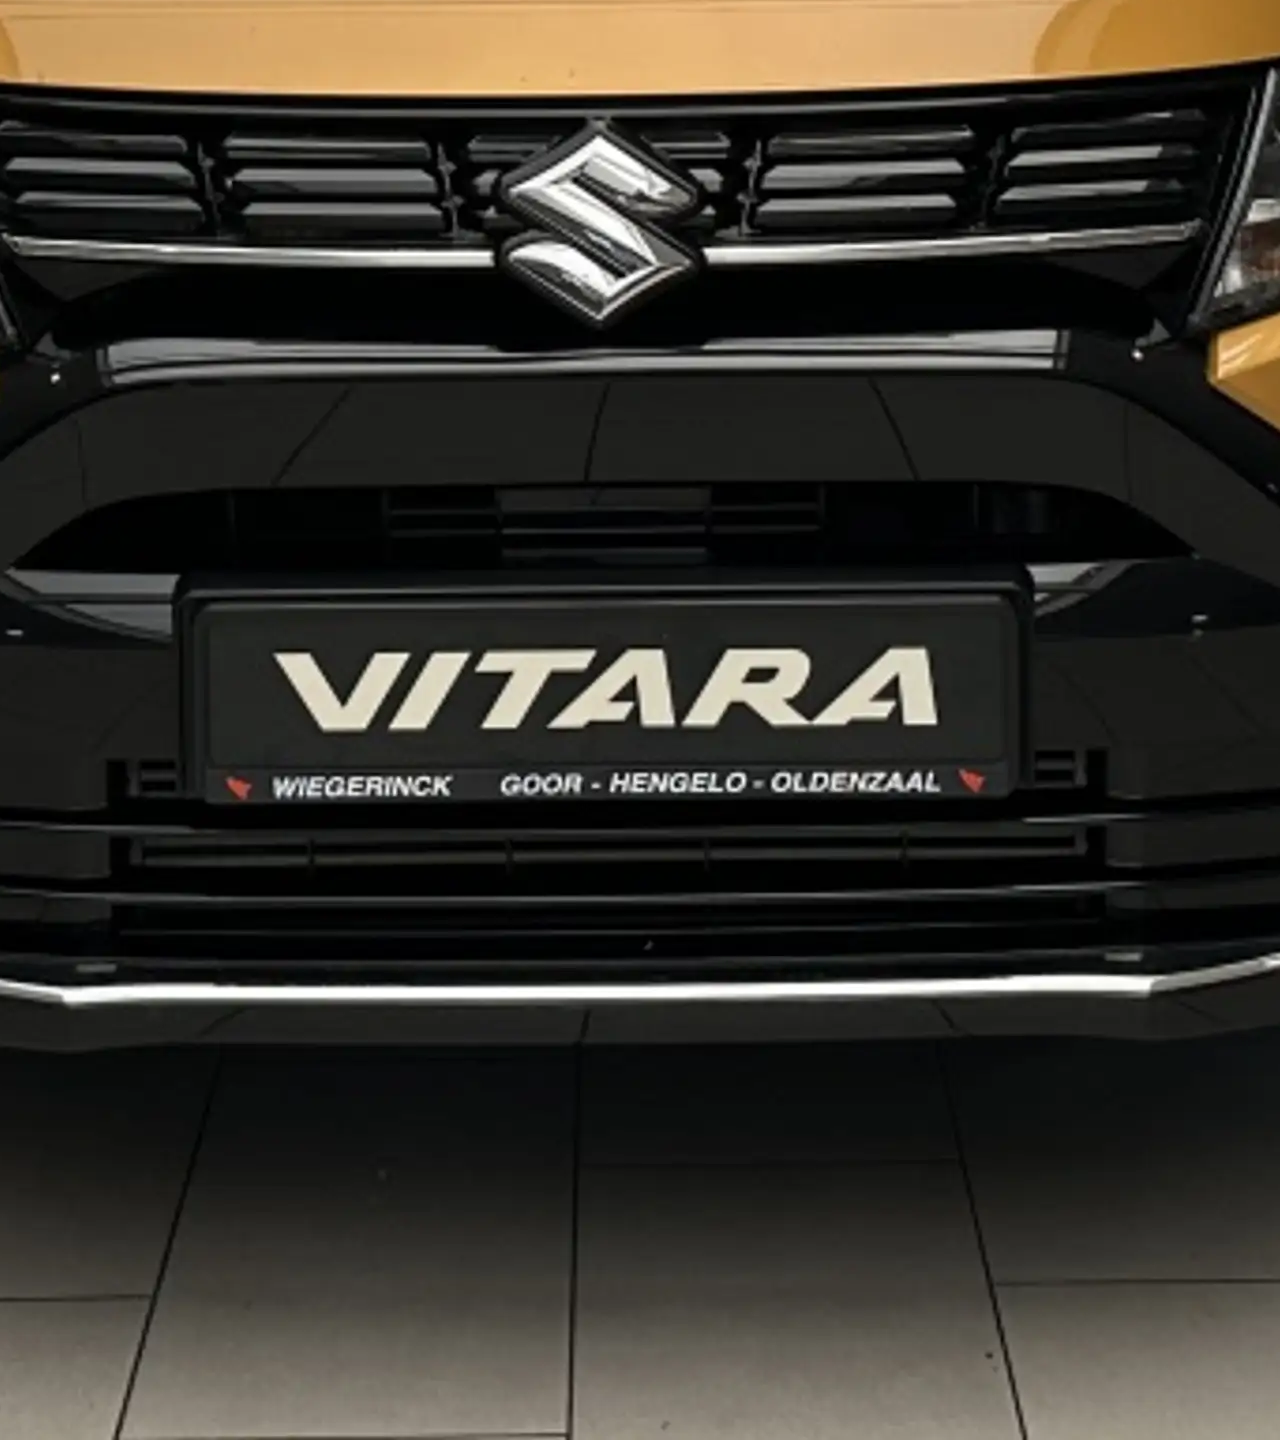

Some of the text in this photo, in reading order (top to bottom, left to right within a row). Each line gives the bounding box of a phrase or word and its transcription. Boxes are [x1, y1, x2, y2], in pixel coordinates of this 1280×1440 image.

[274, 647, 937, 731] VITARA
[273, 776, 453, 799] WIEGERINCK
[500, 773, 583, 796] GOOR
[609, 772, 747, 793] HENGELO
[771, 770, 941, 793] OLDENZAAL
